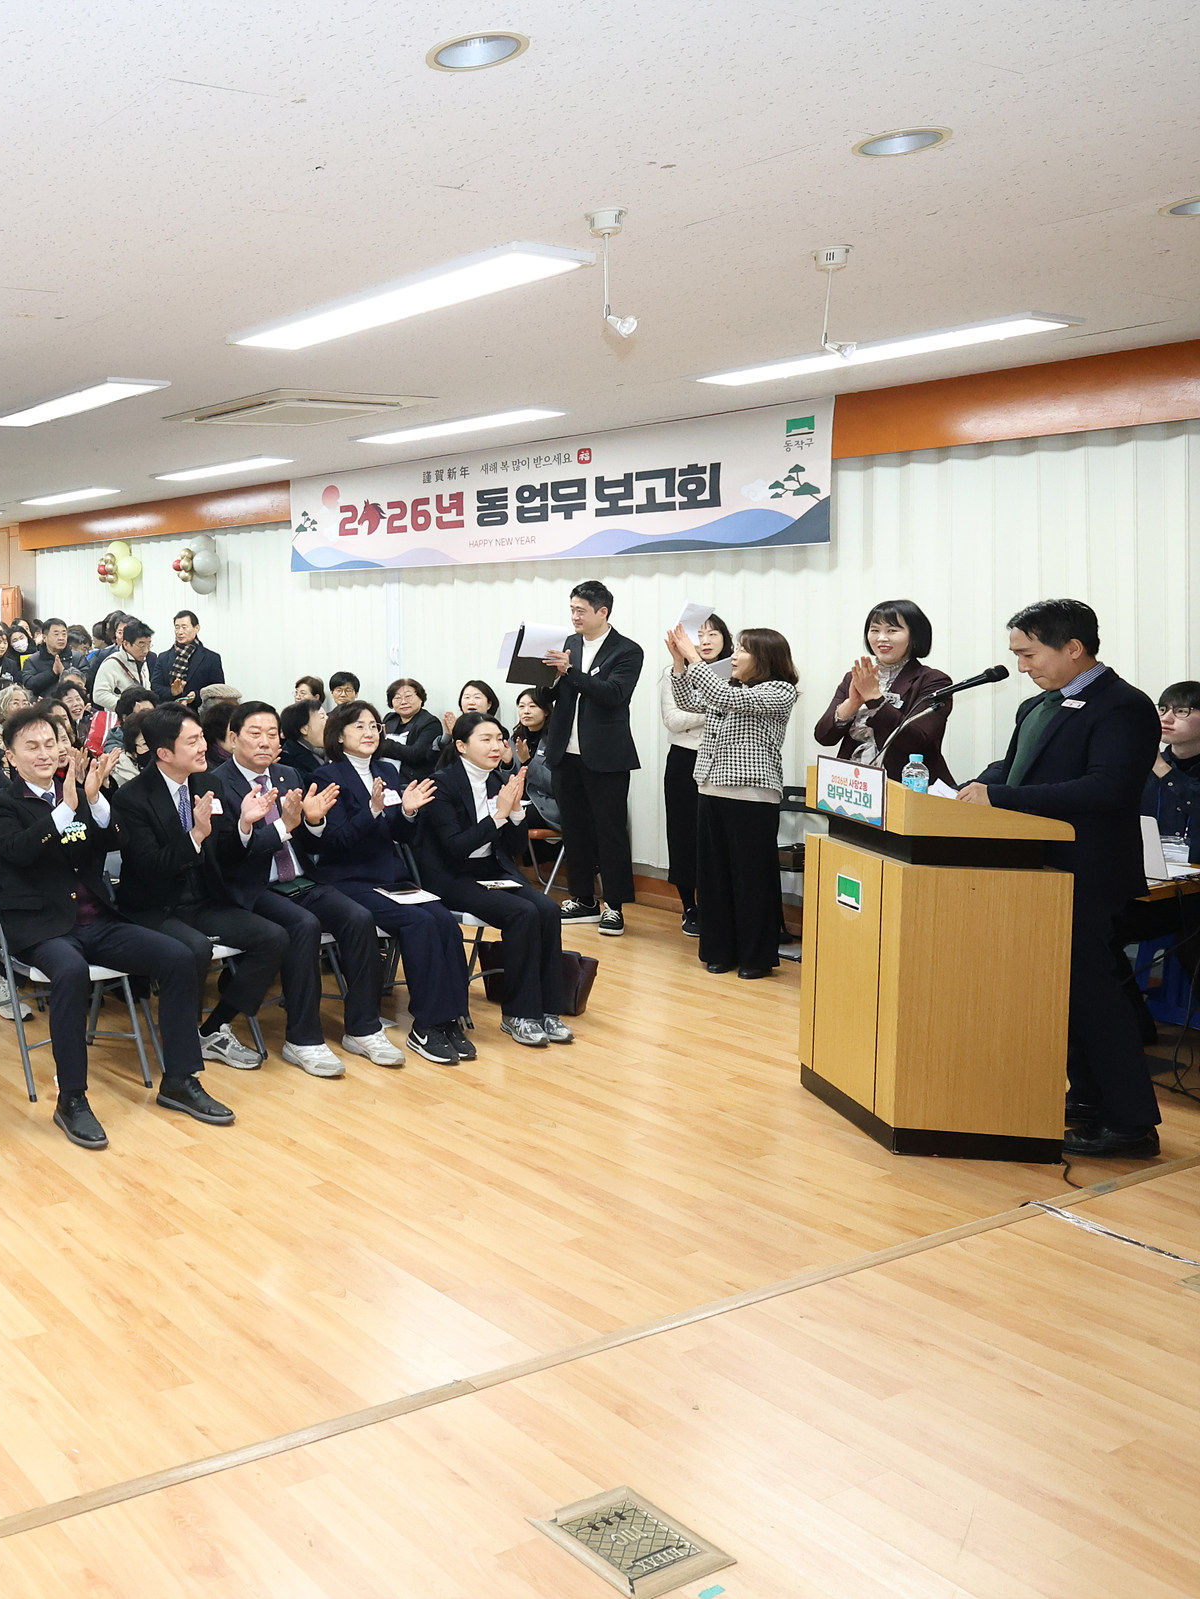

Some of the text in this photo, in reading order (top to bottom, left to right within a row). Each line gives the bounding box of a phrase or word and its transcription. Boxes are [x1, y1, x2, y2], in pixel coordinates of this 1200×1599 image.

[783, 438, 815, 453] 동작구
[480, 453, 572, 475] 새해 복 많이 받으세요
[423, 465, 470, 484] 謹賀新年
[476, 487, 509, 527] 동
[516, 478, 587, 524] 업무
[595, 462, 721, 517] 보고회
[469, 535, 536, 549] HAPPY NEW YEAR
[831, 774, 868, 792] 2026년 사당2동
[827, 783, 872, 809] 업무보고회
